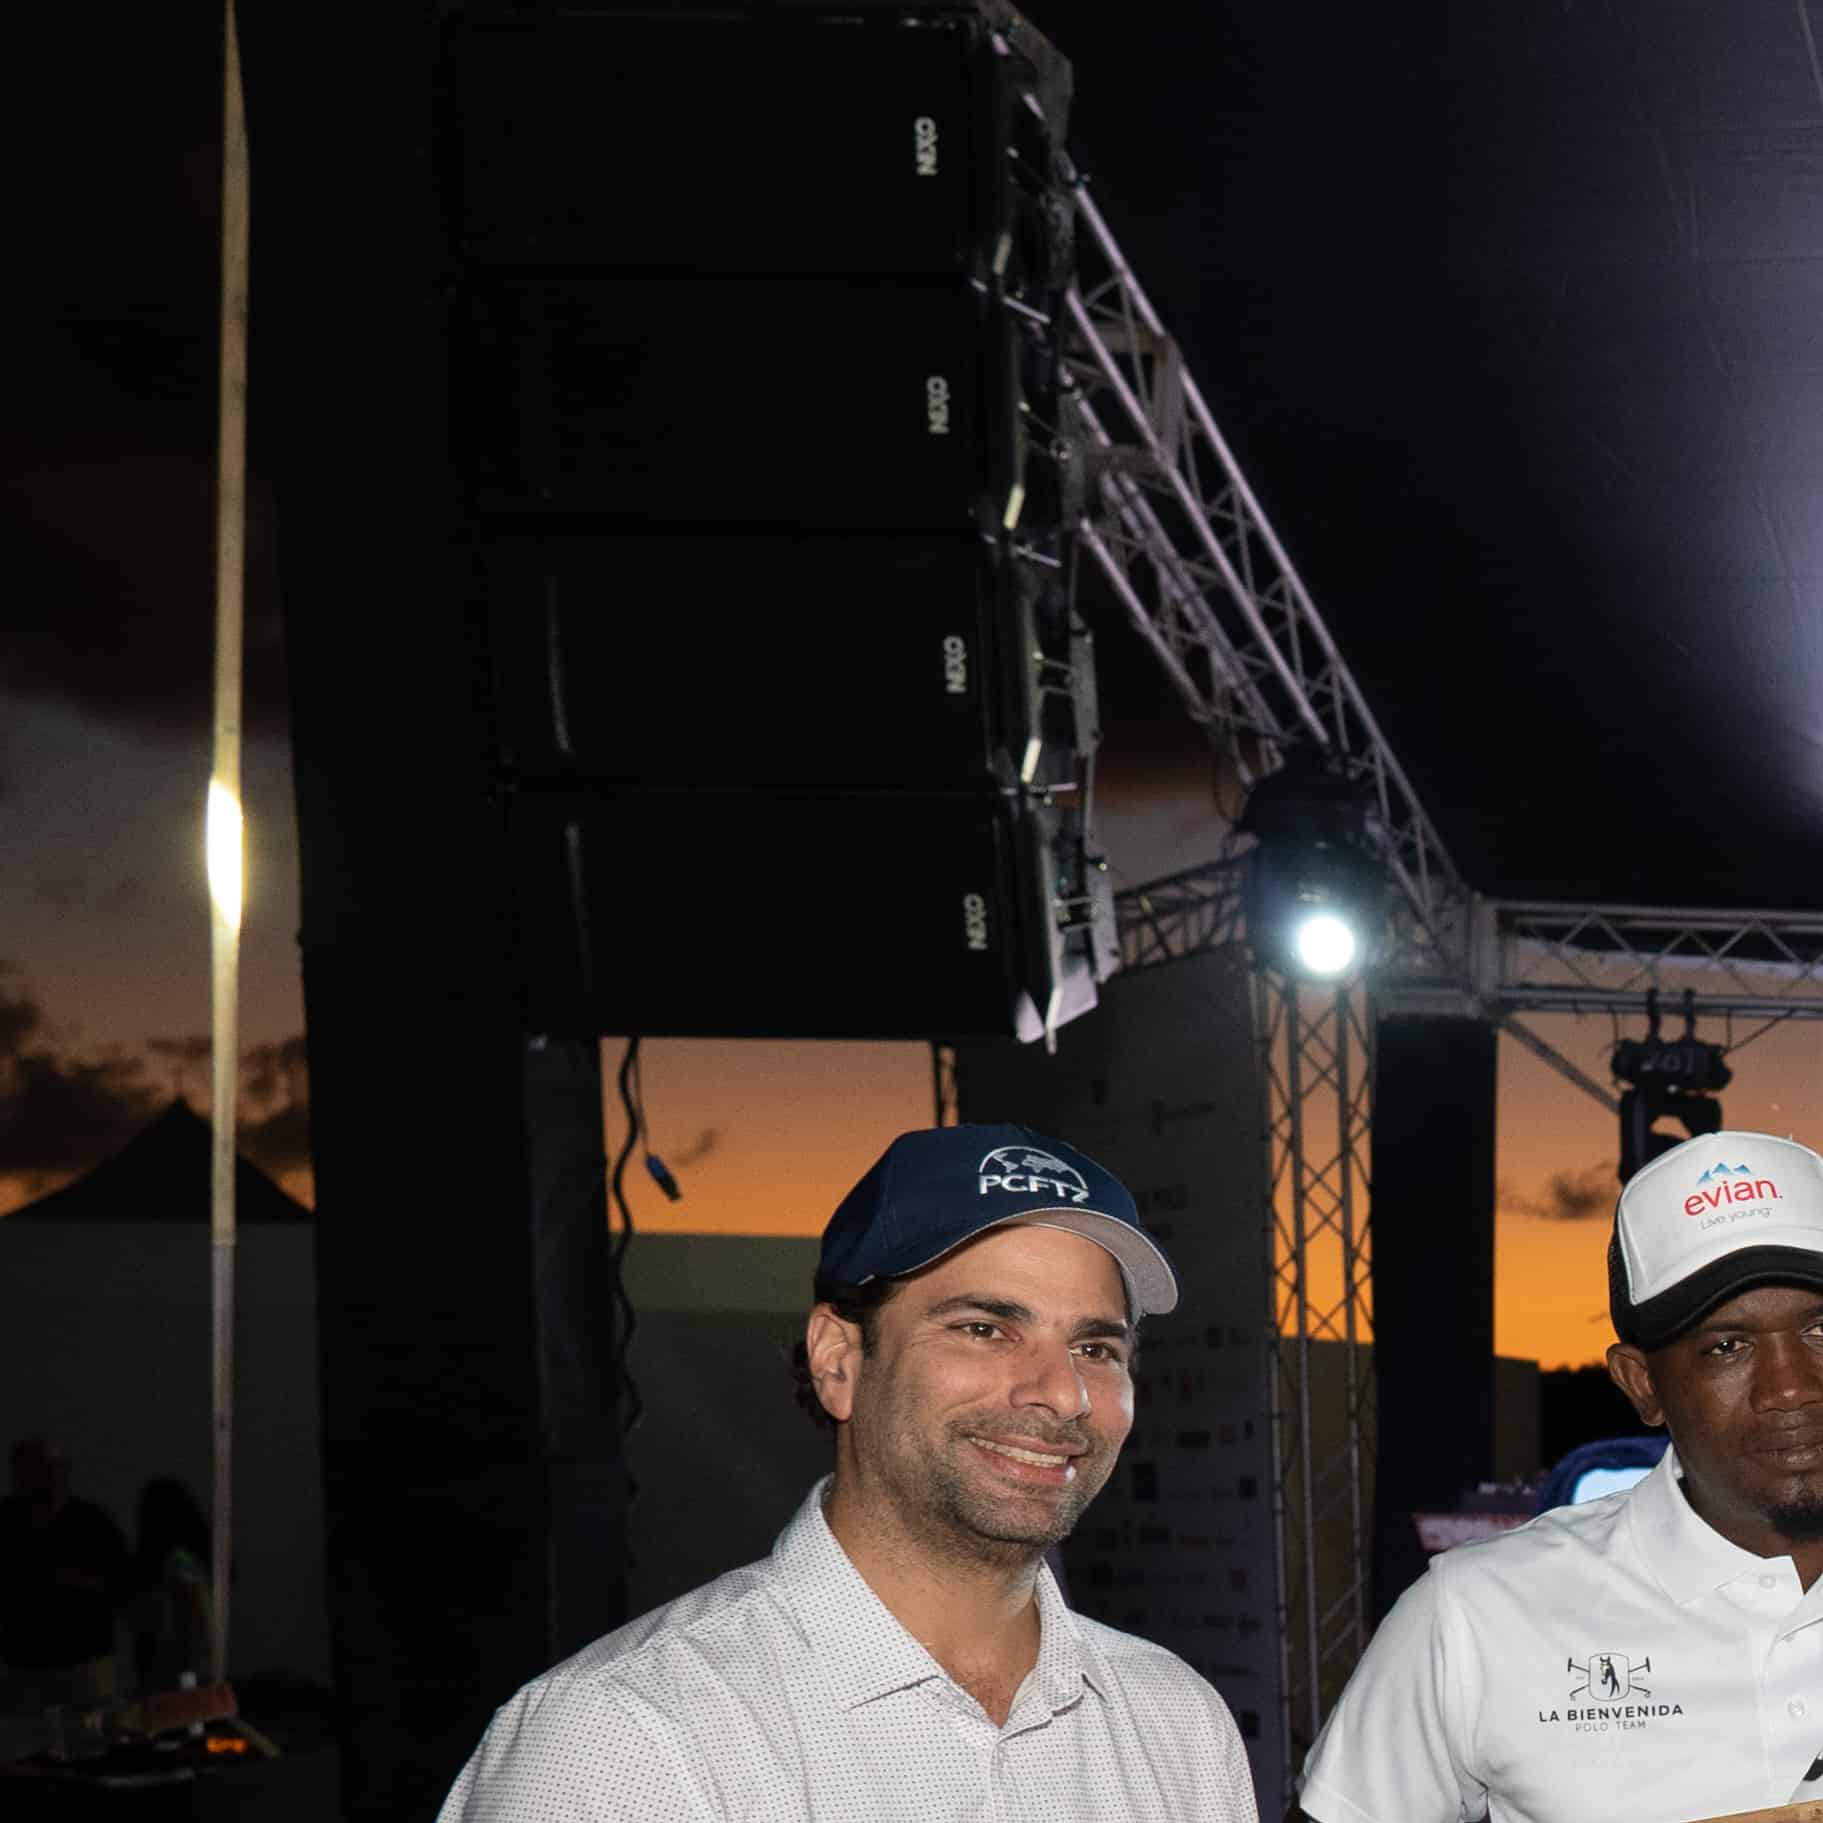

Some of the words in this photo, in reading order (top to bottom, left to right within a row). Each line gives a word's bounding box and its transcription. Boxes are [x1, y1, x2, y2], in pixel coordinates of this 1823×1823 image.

[1539, 1710, 1559, 1722] LA
[1568, 1704, 1684, 1721] BIENVENIDA
[1576, 1722, 1608, 1732] POLO
[1615, 1720, 1646, 1731] TEAM
